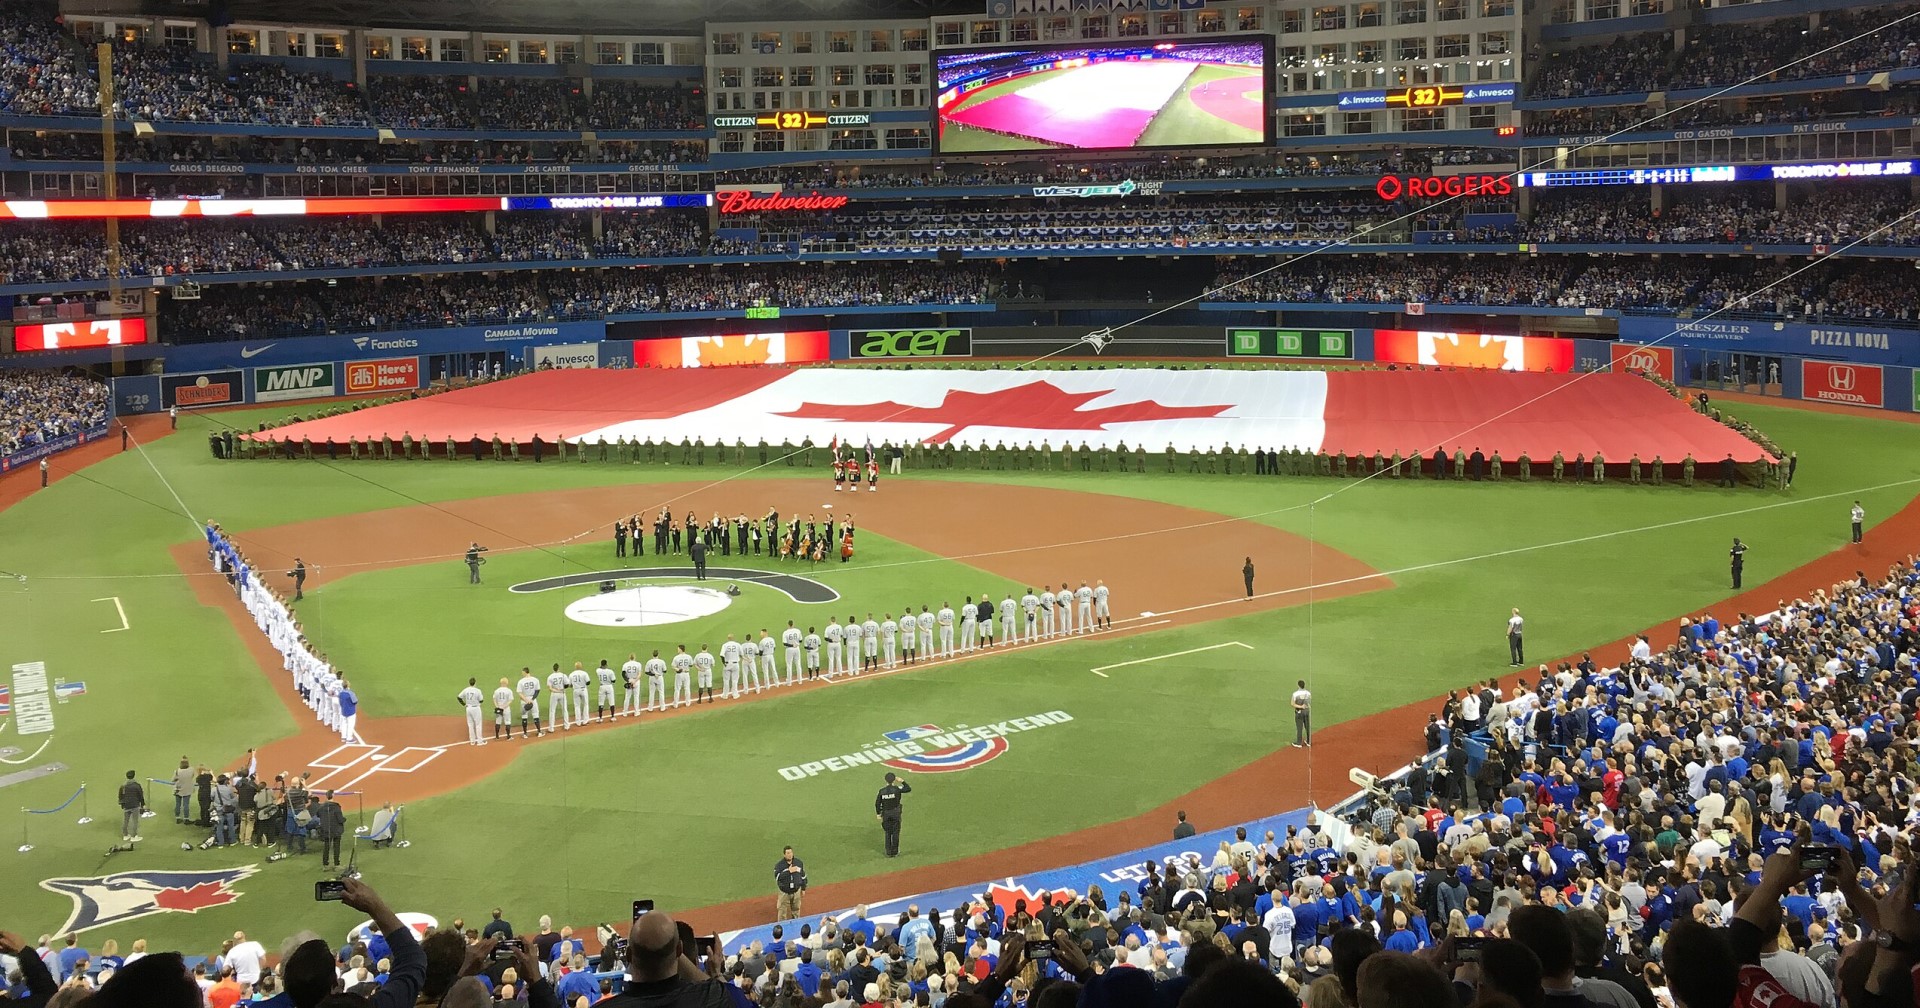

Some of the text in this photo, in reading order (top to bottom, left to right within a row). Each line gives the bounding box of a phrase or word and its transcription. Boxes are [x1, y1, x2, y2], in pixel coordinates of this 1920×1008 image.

[1413, 88, 1435, 105] 32
[1479, 88, 1514, 97] Invesco
[1352, 95, 1386, 104] Invesco
[714, 116, 756, 127] CITIZEN
[782, 113, 803, 128] 32
[828, 114, 870, 125] CITIZEN
[1812, 122, 1847, 131] GILLICK
[1674, 129, 1734, 139] CITO GASTON
[170, 164, 244, 173] CARLOS DELGADO
[296, 165, 317, 173] 4306
[320, 165, 339, 173] TOM
[409, 165, 430, 173] TONY
[524, 165, 539, 173] JOE
[628, 164, 659, 172] GEORGE
[1772, 164, 1836, 178] TORONTO
[1137, 181, 1163, 189] FLIGHT
[1408, 175, 1512, 197] ROGERS
[1034, 186, 1118, 197] WESTJET
[1140, 188, 1160, 196] DECK
[550, 197, 602, 208] TORONTO
[717, 190, 847, 213] Budweiser
[484, 327, 558, 338] CANADA MOVING
[1676, 322, 1750, 334] PRESZLER
[1709, 333, 1744, 341] LAWYERS
[1811, 330, 1889, 350] PIZZA NOVA
[371, 338, 418, 350] Fanatics
[860, 329, 961, 357] acer
[1237, 335, 1343, 351] TD TD TD
[556, 354, 595, 365] Invesco
[1581, 357, 1599, 367] 375
[1630, 354, 1654, 370] DQ
[378, 363, 414, 375] Here's
[266, 368, 324, 391] MNP
[378, 376, 407, 387] How.
[180, 387, 227, 400] SCHNEIDERS
[1818, 390, 1866, 403] HONDA
[125, 394, 149, 405] 328
[699, 657, 709, 665] 30
[524, 681, 534, 690] 99
[553, 677, 563, 685] 27
[777, 710, 1074, 781] OPENING WEEKEND
[1616, 840, 1630, 853] 12
[1277, 920, 1290, 935] 25
